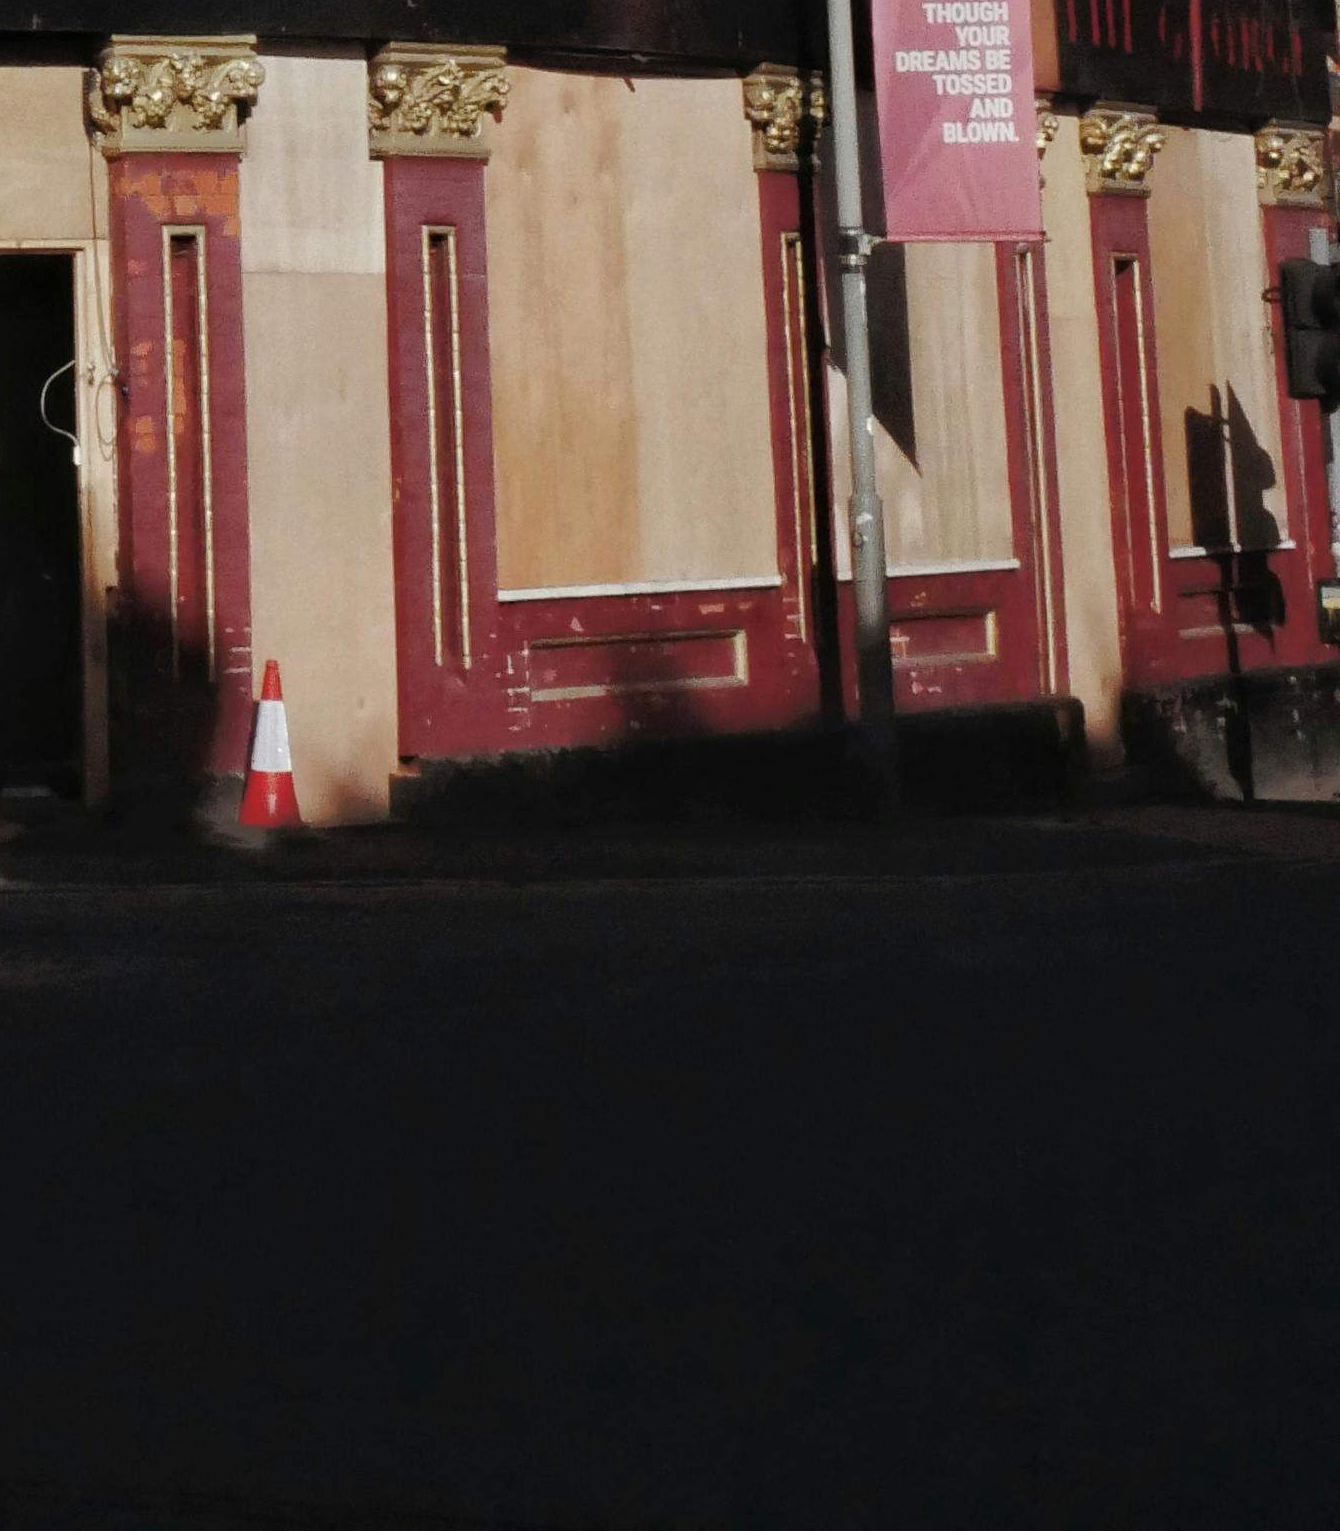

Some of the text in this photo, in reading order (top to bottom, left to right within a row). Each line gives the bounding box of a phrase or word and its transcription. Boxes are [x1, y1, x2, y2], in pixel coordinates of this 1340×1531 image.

[921, 1, 1009, 24] THOUGH
[954, 25, 1010, 47] YOUR
[895, 49, 1012, 72] DREAMS BE
[931, 73, 1013, 96] TOSSED
[969, 97, 1014, 119] AND
[942, 121, 1020, 144] BLOWN.
